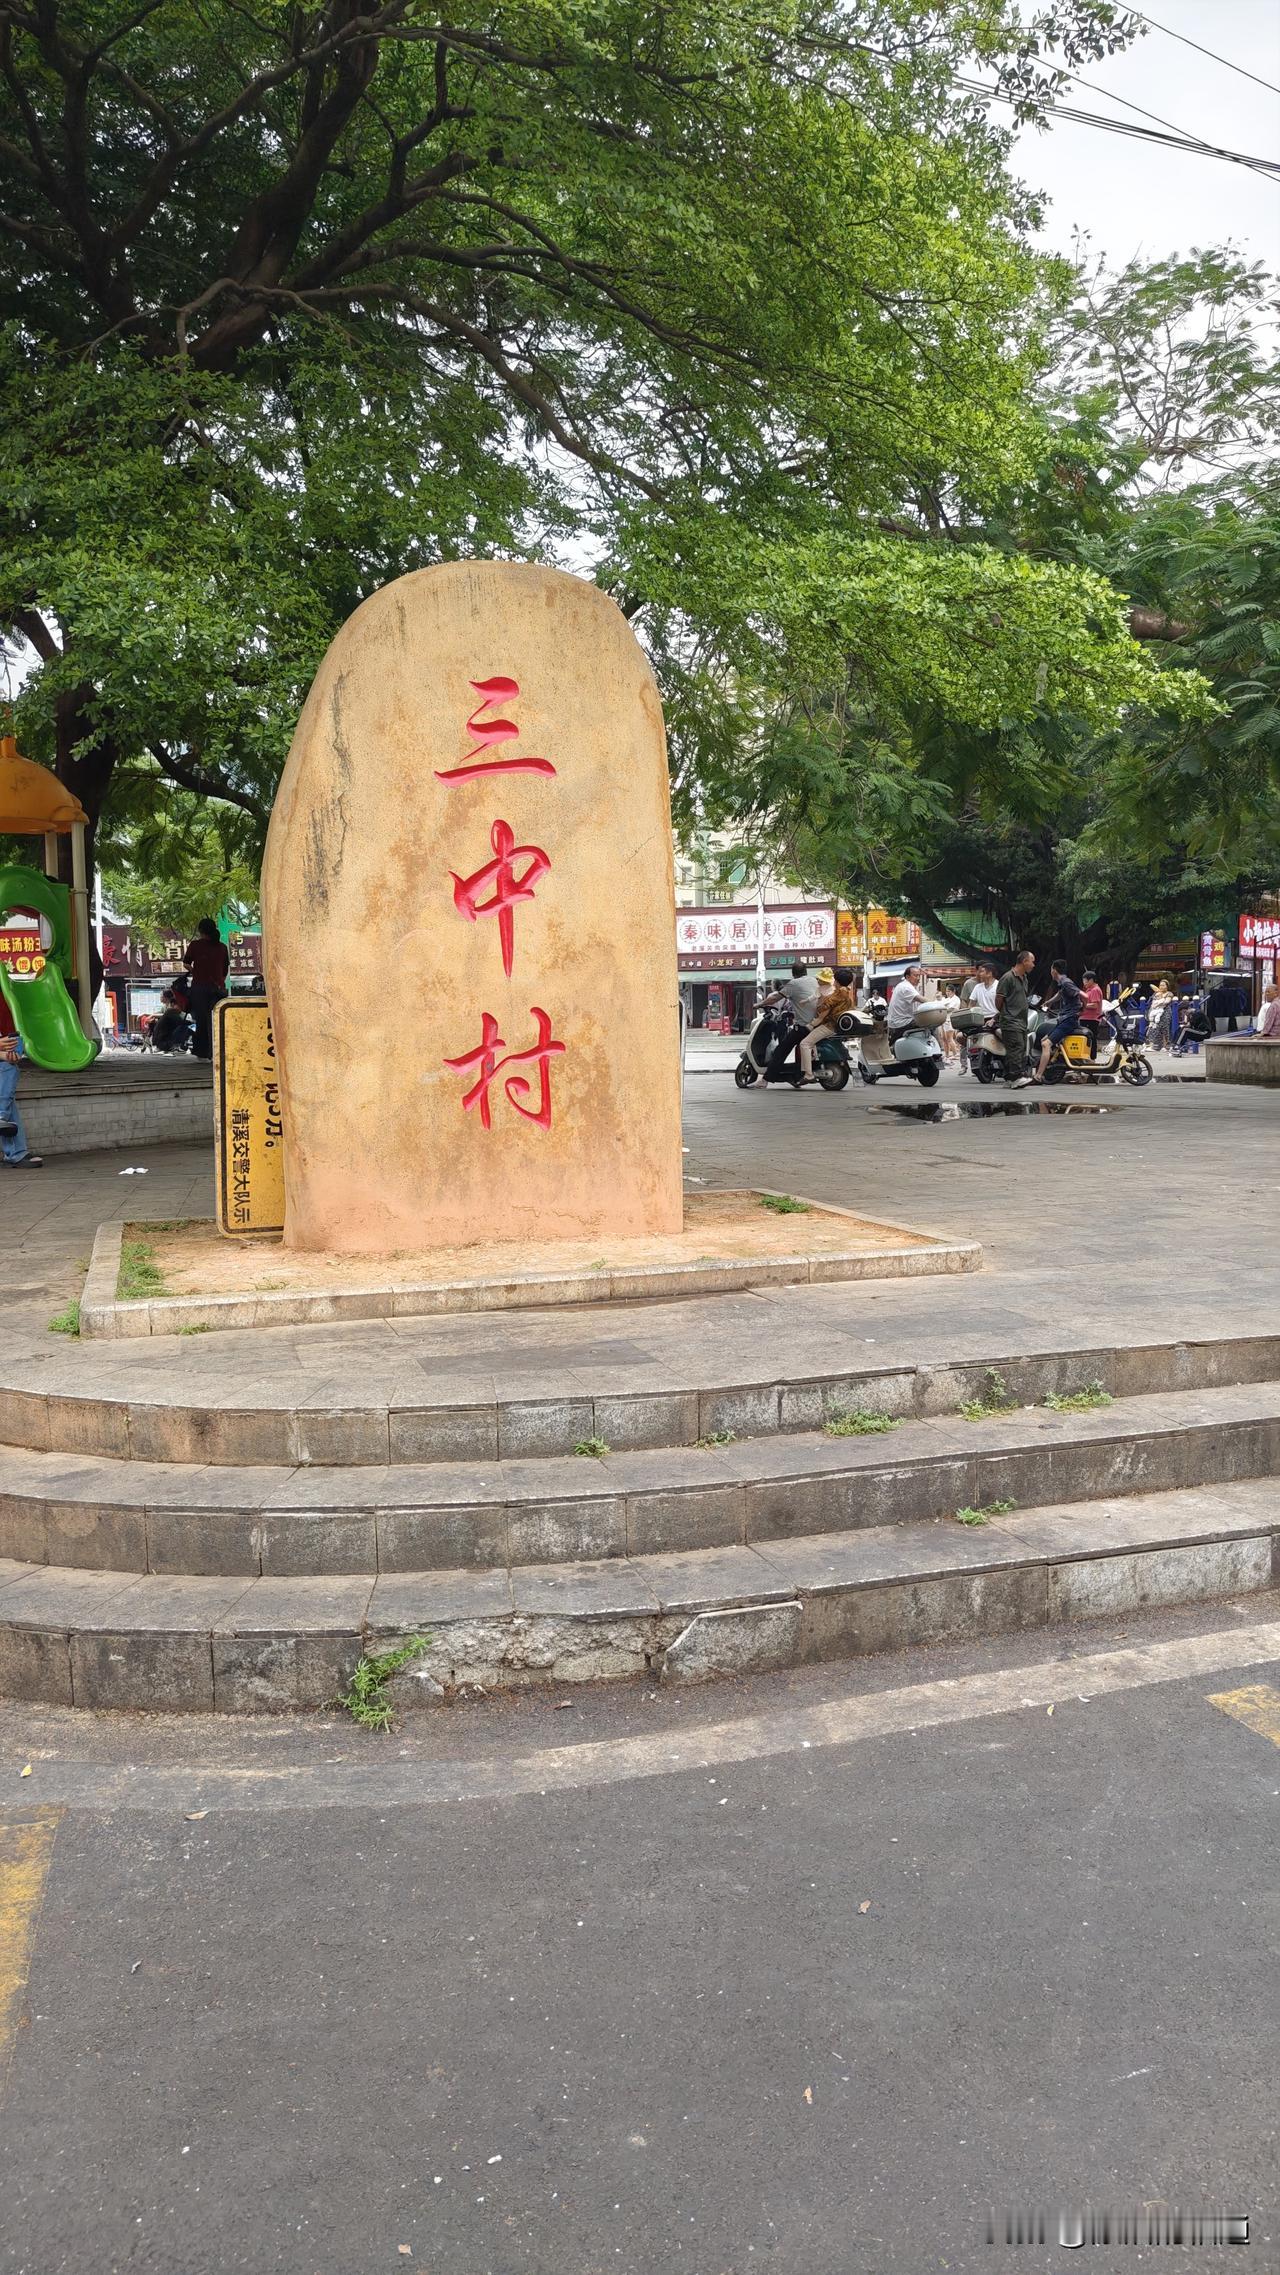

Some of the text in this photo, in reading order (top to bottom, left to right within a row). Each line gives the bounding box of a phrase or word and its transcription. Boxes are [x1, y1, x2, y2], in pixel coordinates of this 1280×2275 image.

[434, 677, 566, 1131] 三中村
[708, 958, 735, 967] 小龙虾
[231, 1108, 251, 1224] 清溪交警大队示
